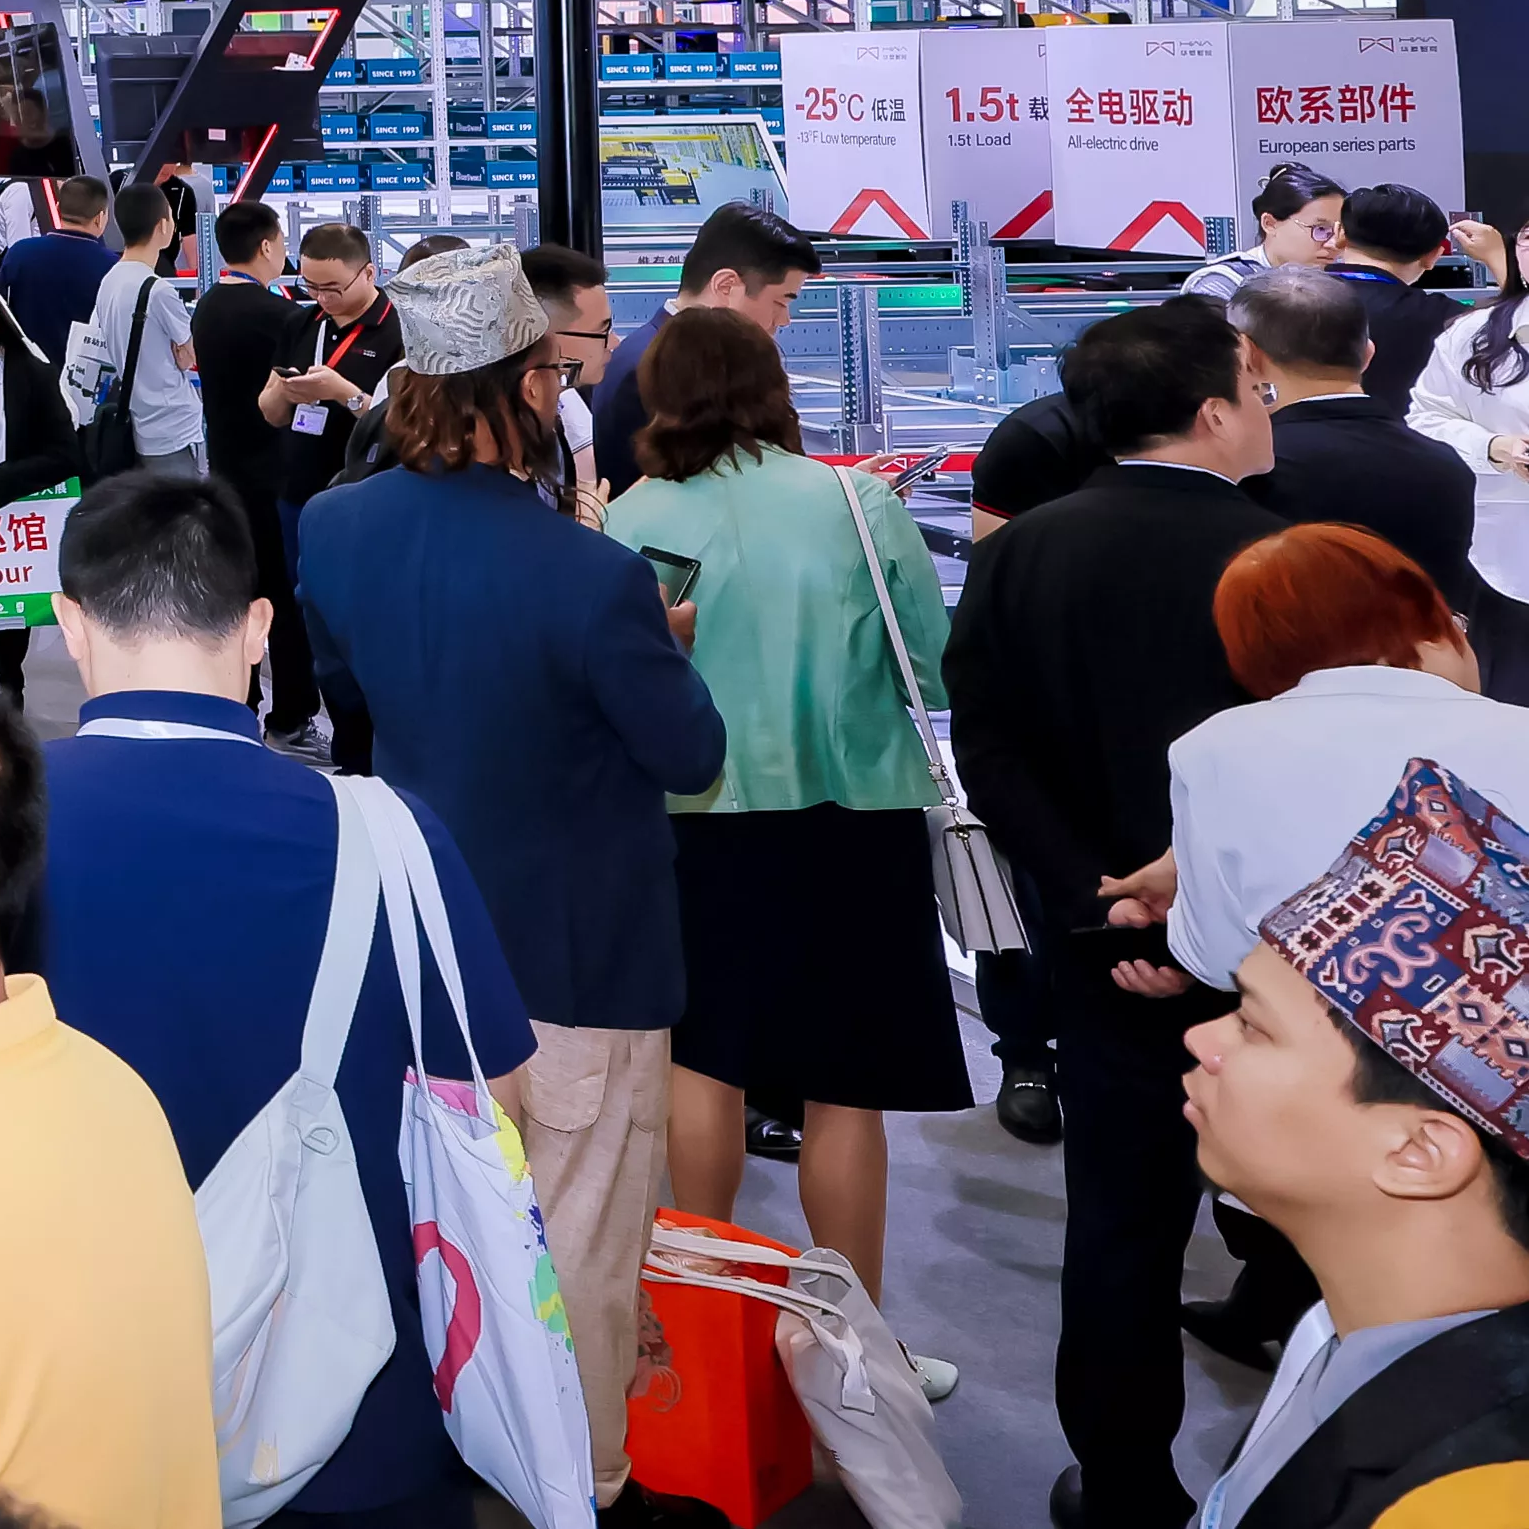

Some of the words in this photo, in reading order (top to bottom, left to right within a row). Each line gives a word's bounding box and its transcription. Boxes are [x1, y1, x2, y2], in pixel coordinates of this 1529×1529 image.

[871, 97, 907, 122] 低温
[945, 86, 1020, 122] 1.5t
[1065, 87, 1194, 127] 全电驱动
[1256, 83, 1416, 126] 欧系部件
[820, 131, 839, 144] Low
[841, 133, 896, 148] temperature
[948, 134, 972, 147] 1.5t
[976, 133, 1012, 146] Load
[1067, 135, 1128, 151] All-electric
[1130, 137, 1159, 151] drive
[1259, 138, 1329, 156] European
[1332, 139, 1375, 153] series
[1378, 138, 1416, 155] parts
